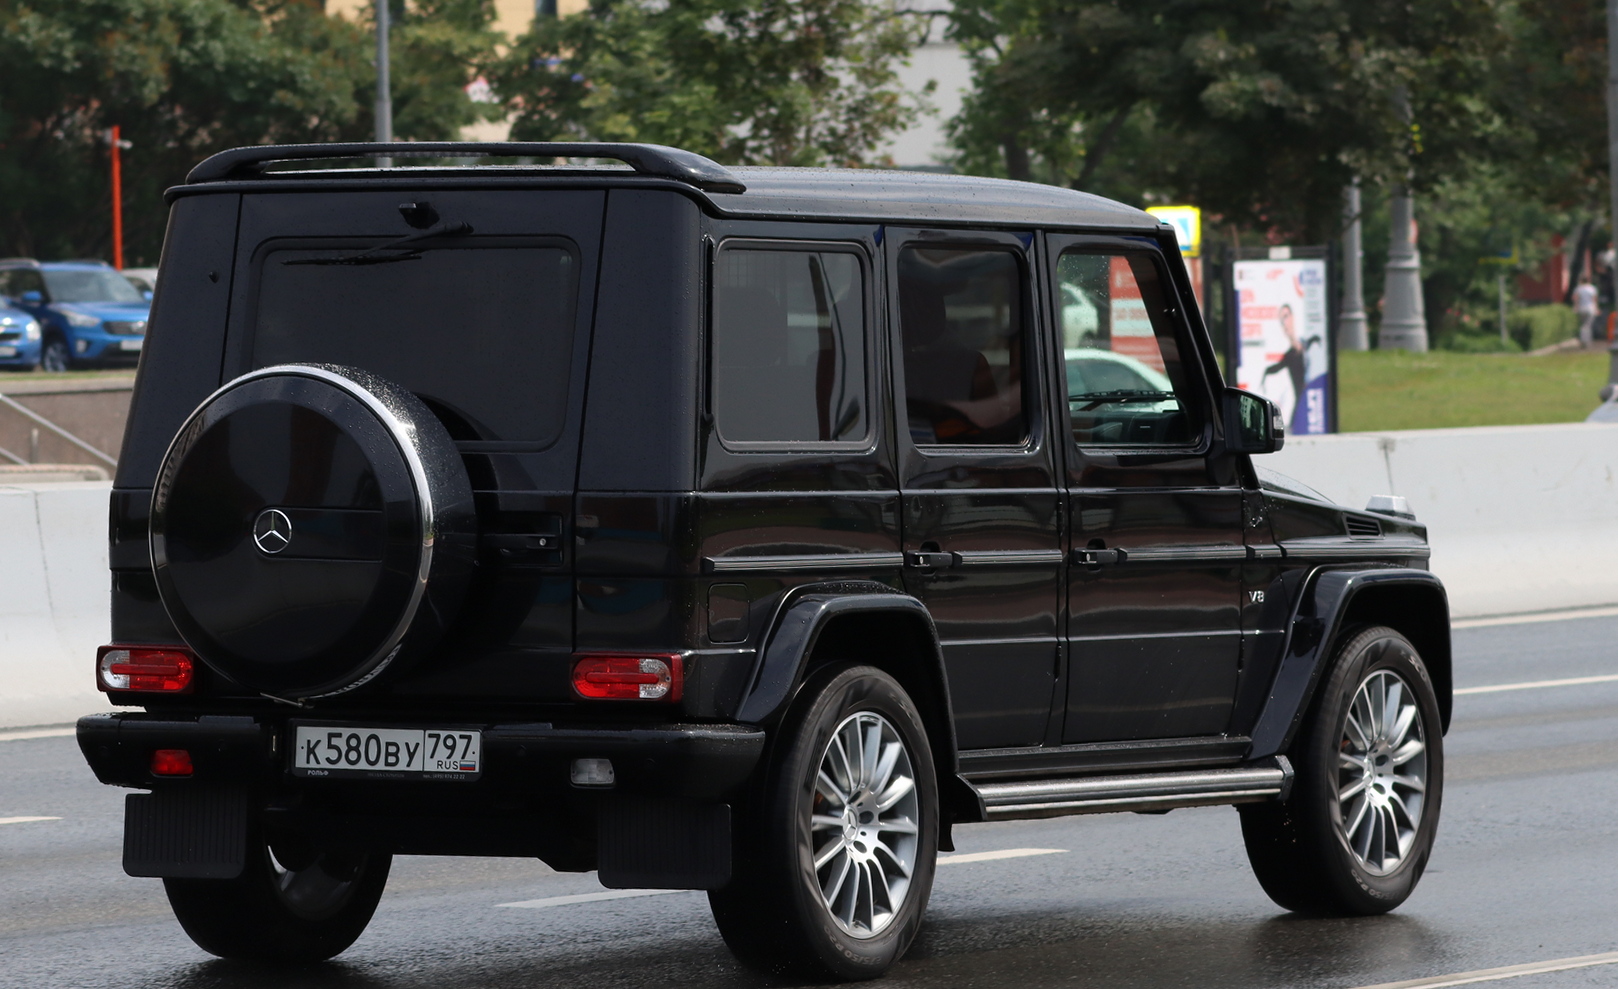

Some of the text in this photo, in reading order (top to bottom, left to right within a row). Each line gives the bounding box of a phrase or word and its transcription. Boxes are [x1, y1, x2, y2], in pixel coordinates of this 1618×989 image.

[1248, 590, 1265, 603] V8
[427, 733, 473, 760] 797
[436, 760, 459, 770] RUS
